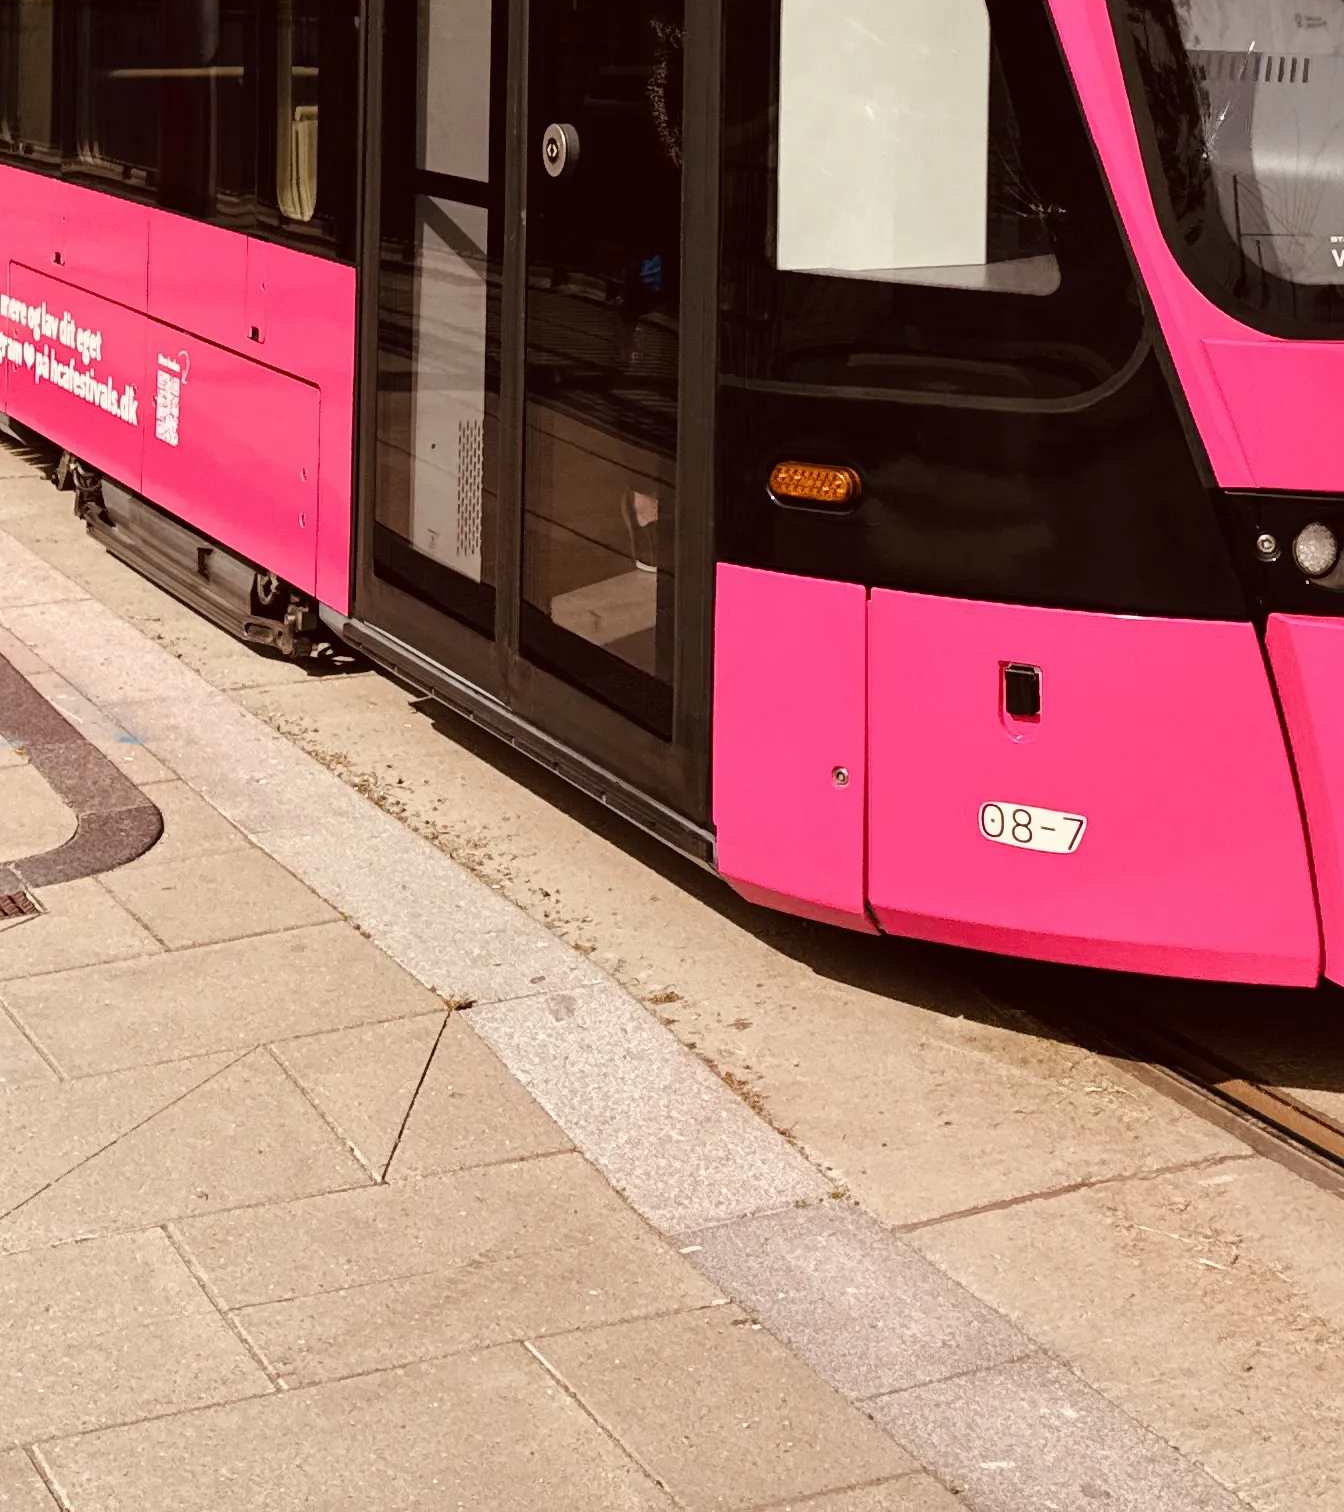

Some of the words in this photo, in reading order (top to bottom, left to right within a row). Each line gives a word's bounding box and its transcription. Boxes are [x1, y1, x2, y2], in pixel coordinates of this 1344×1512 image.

[0, 293, 27, 326] mere
[27, 305, 41, 341] og
[42, 301, 58, 340] lav
[59, 311, 76, 349] dit
[76, 327, 102, 365] eget
[35, 343, 49, 384] på
[50, 348, 139, 426] hcafestivals.dk
[981, 803, 1084, 851] 08-7
